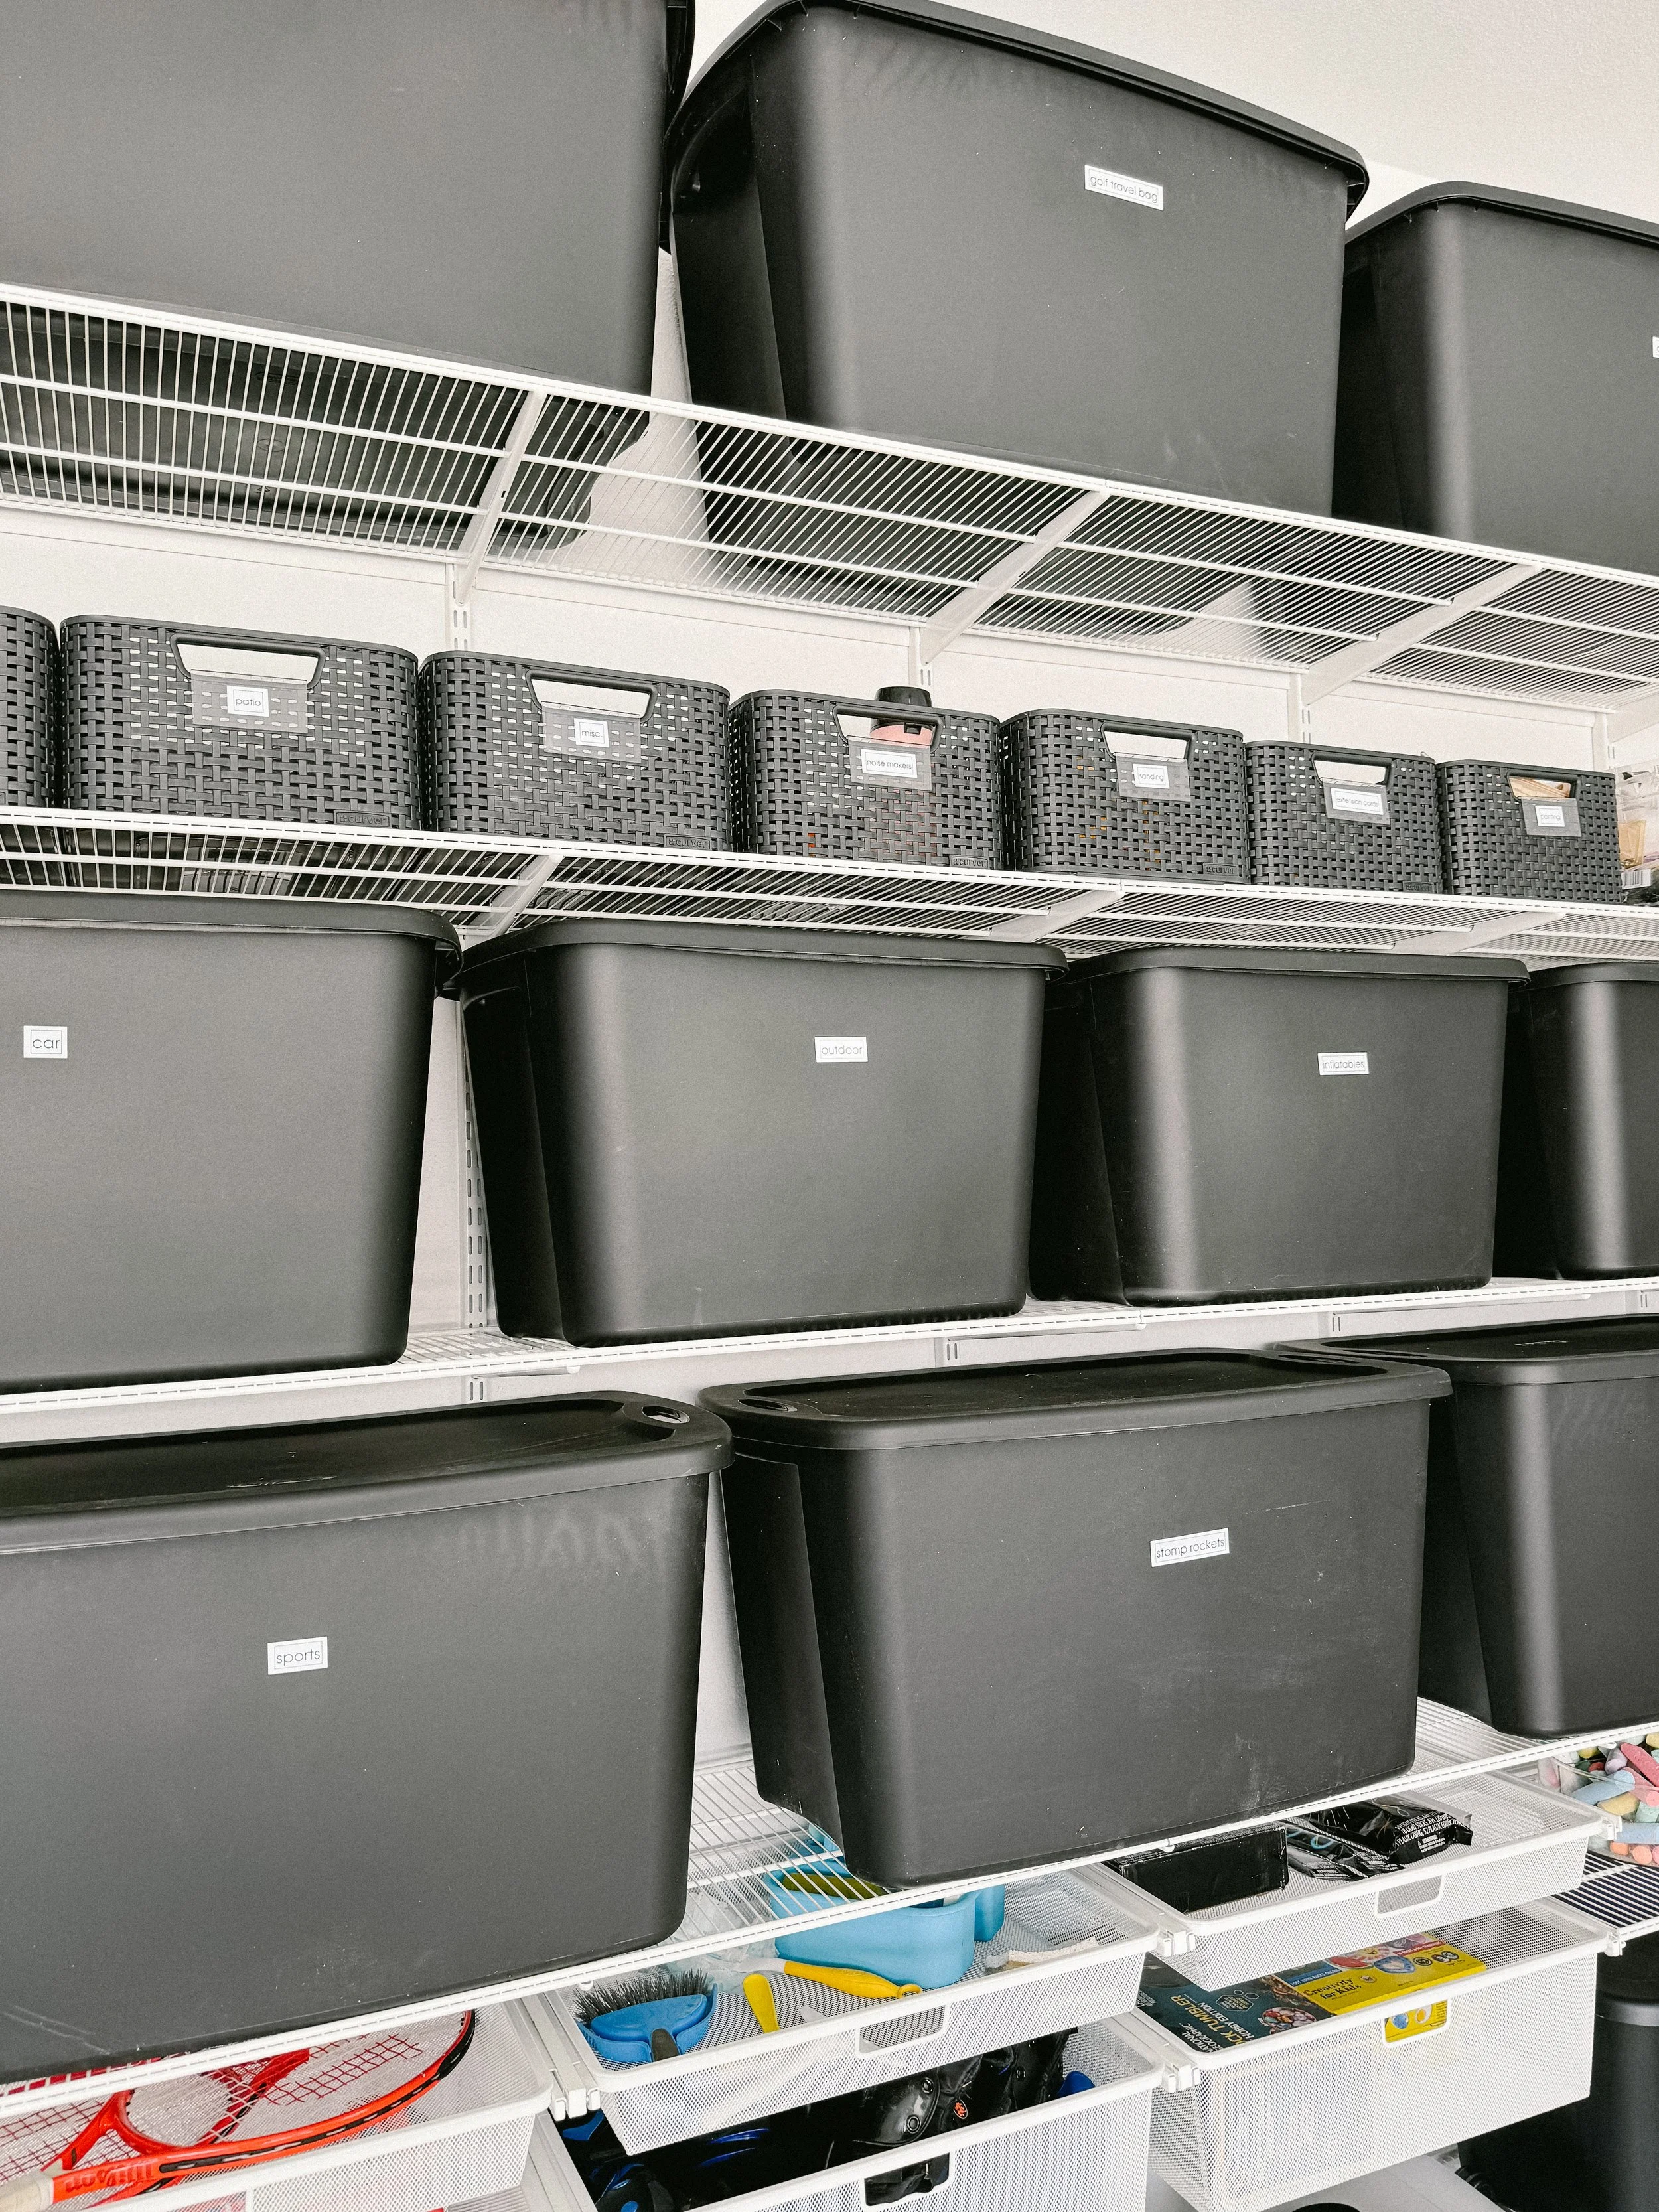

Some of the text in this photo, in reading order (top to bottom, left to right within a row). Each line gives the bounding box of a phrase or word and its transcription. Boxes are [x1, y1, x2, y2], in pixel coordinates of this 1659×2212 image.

[1090, 176, 1157, 204] golf travel bag
[236, 698, 261, 707] patio
[581, 729, 603, 738] misc.
[1139, 773, 1164, 782] sanding
[348, 815, 386, 825] curver
[676, 839, 707, 848] curver
[32, 1039, 60, 1049] car
[821, 1045, 863, 1055] outdoor
[1322, 1059, 1365, 1069] inflatables
[1156, 1538, 1225, 1558] stomp rockets
[276, 1649, 321, 1666] sports
[1396, 1834, 1412, 1846] PLASTIC
[1410, 1829, 1425, 1840] CASING,
[1427, 1822, 1443, 1834] PLASTIC
[1406, 1822, 1417, 1833] LIGHT
[1415, 1820, 1430, 1830] STICKS,
[1303, 1978, 1354, 1996] Creativity
[1320, 1991, 1336, 2000] for
[1334, 1985, 1362, 1995] Kids
[1170, 1994, 1225, 2032] TUMBLER
[1197, 2002, 1229, 2022] EDITION
[1220, 2030, 1248, 2046] OCK
[1224, 2021, 1255, 2040] HOBBY
[65, 2164, 154, 2193] Wilson
